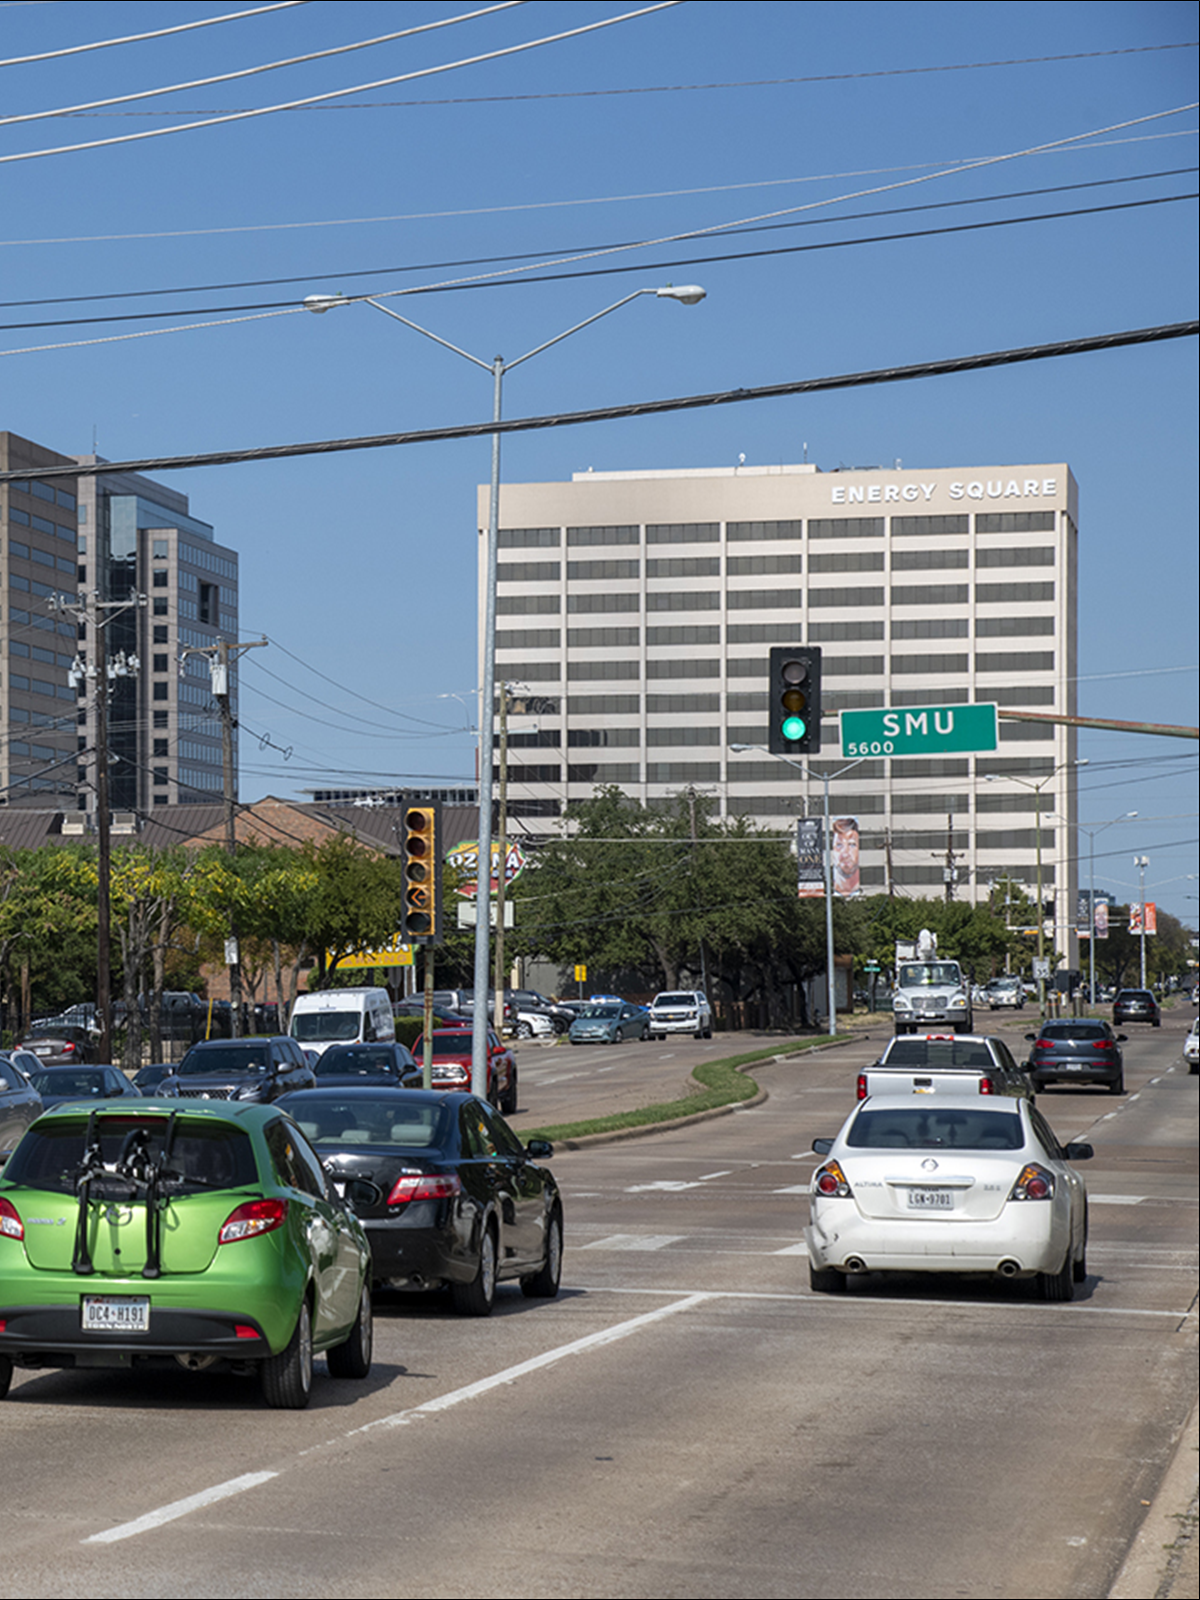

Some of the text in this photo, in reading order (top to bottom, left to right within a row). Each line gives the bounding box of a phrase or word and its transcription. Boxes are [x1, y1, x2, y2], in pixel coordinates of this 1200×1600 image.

[831, 478, 1058, 504] ENERGY SQUARE
[883, 710, 954, 737] SMU
[848, 741, 894, 755] 5600
[799, 855, 822, 864] ONE
